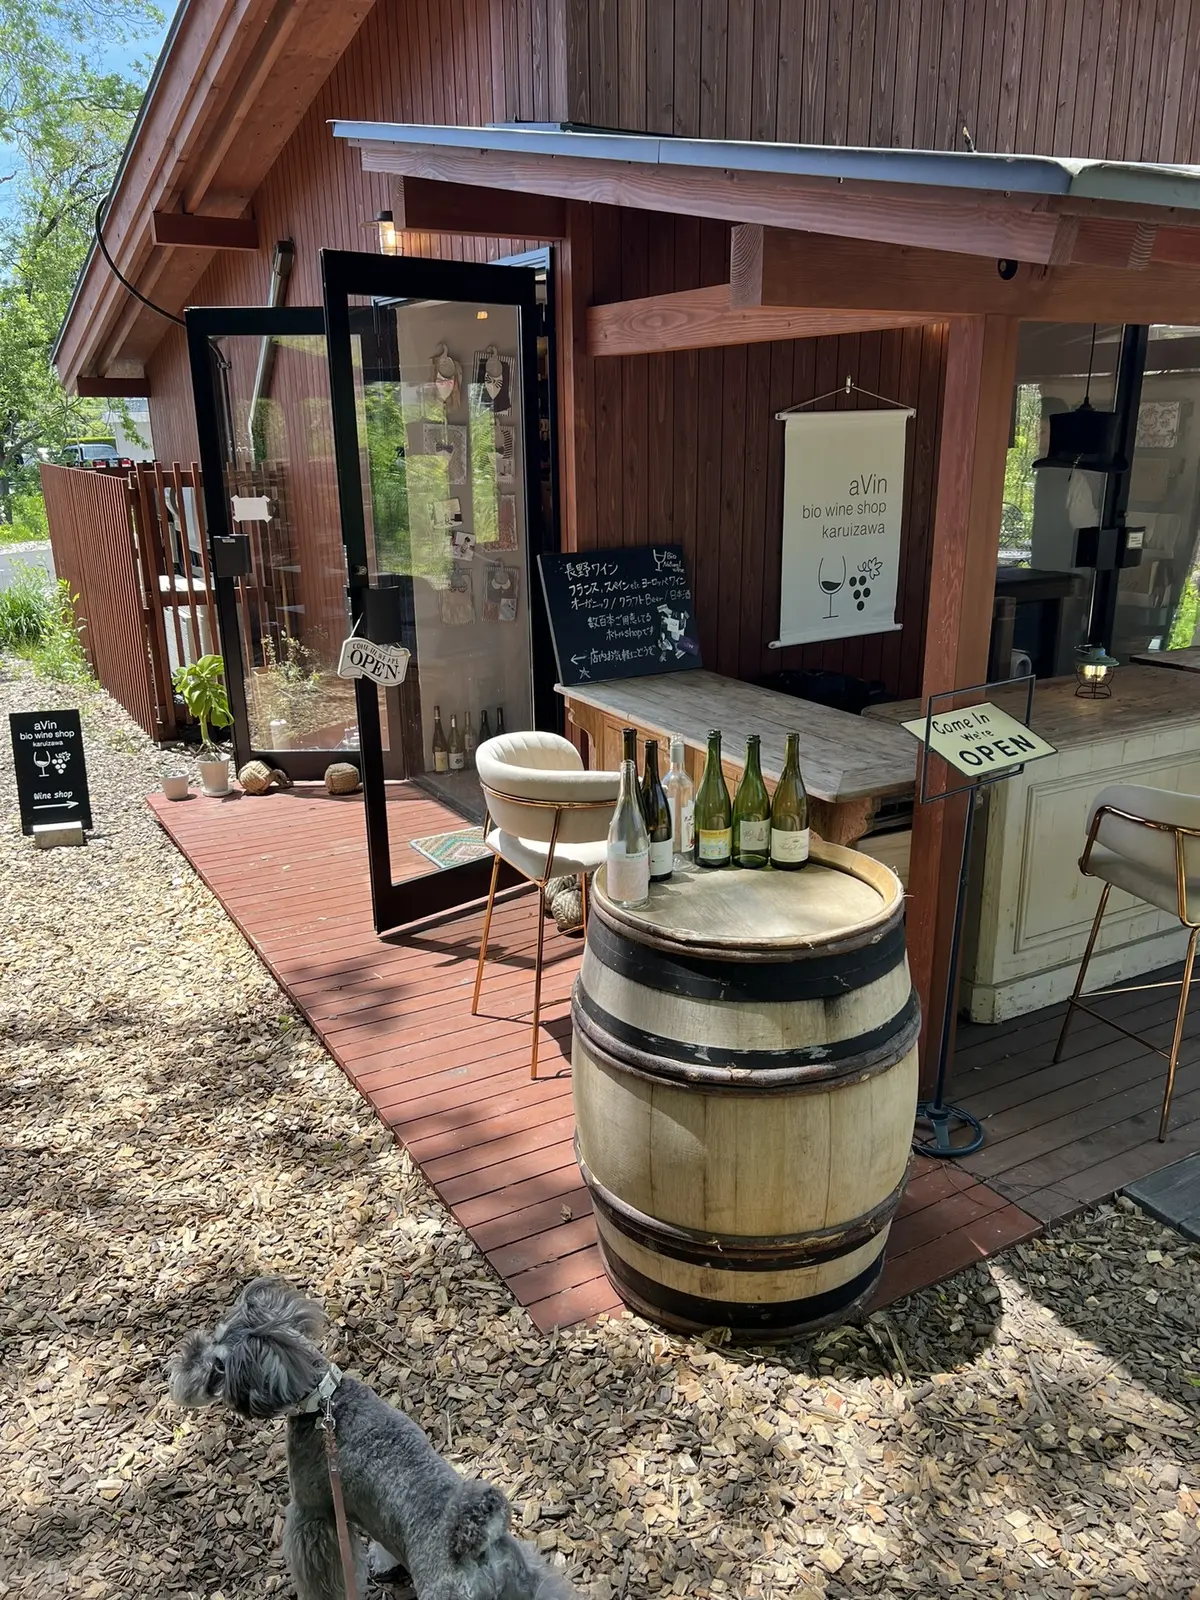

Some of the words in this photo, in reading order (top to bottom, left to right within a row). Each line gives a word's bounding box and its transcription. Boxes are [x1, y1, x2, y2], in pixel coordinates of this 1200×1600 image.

[849, 473, 888, 496] aVin
[802, 504, 822, 519] bio
[825, 502, 853, 517] wine
[857, 500, 887, 515] shop
[822, 522, 885, 539] karuizawa
[564, 562, 618, 581] 長野ワイン
[350, 649, 399, 680] OPEN
[33, 720, 57, 731] aVin
[932, 716, 974, 735] Come
[972, 712, 990, 725] In
[20, 732, 33, 740] bio
[34, 731, 53, 739] wine
[55, 730, 75, 739] shop
[32, 740, 64, 748] karuizawa
[960, 729, 994, 742] We're
[958, 734, 1036, 766] OPEN
[33, 791, 52, 800] Wine
[54, 790, 73, 799] shop
